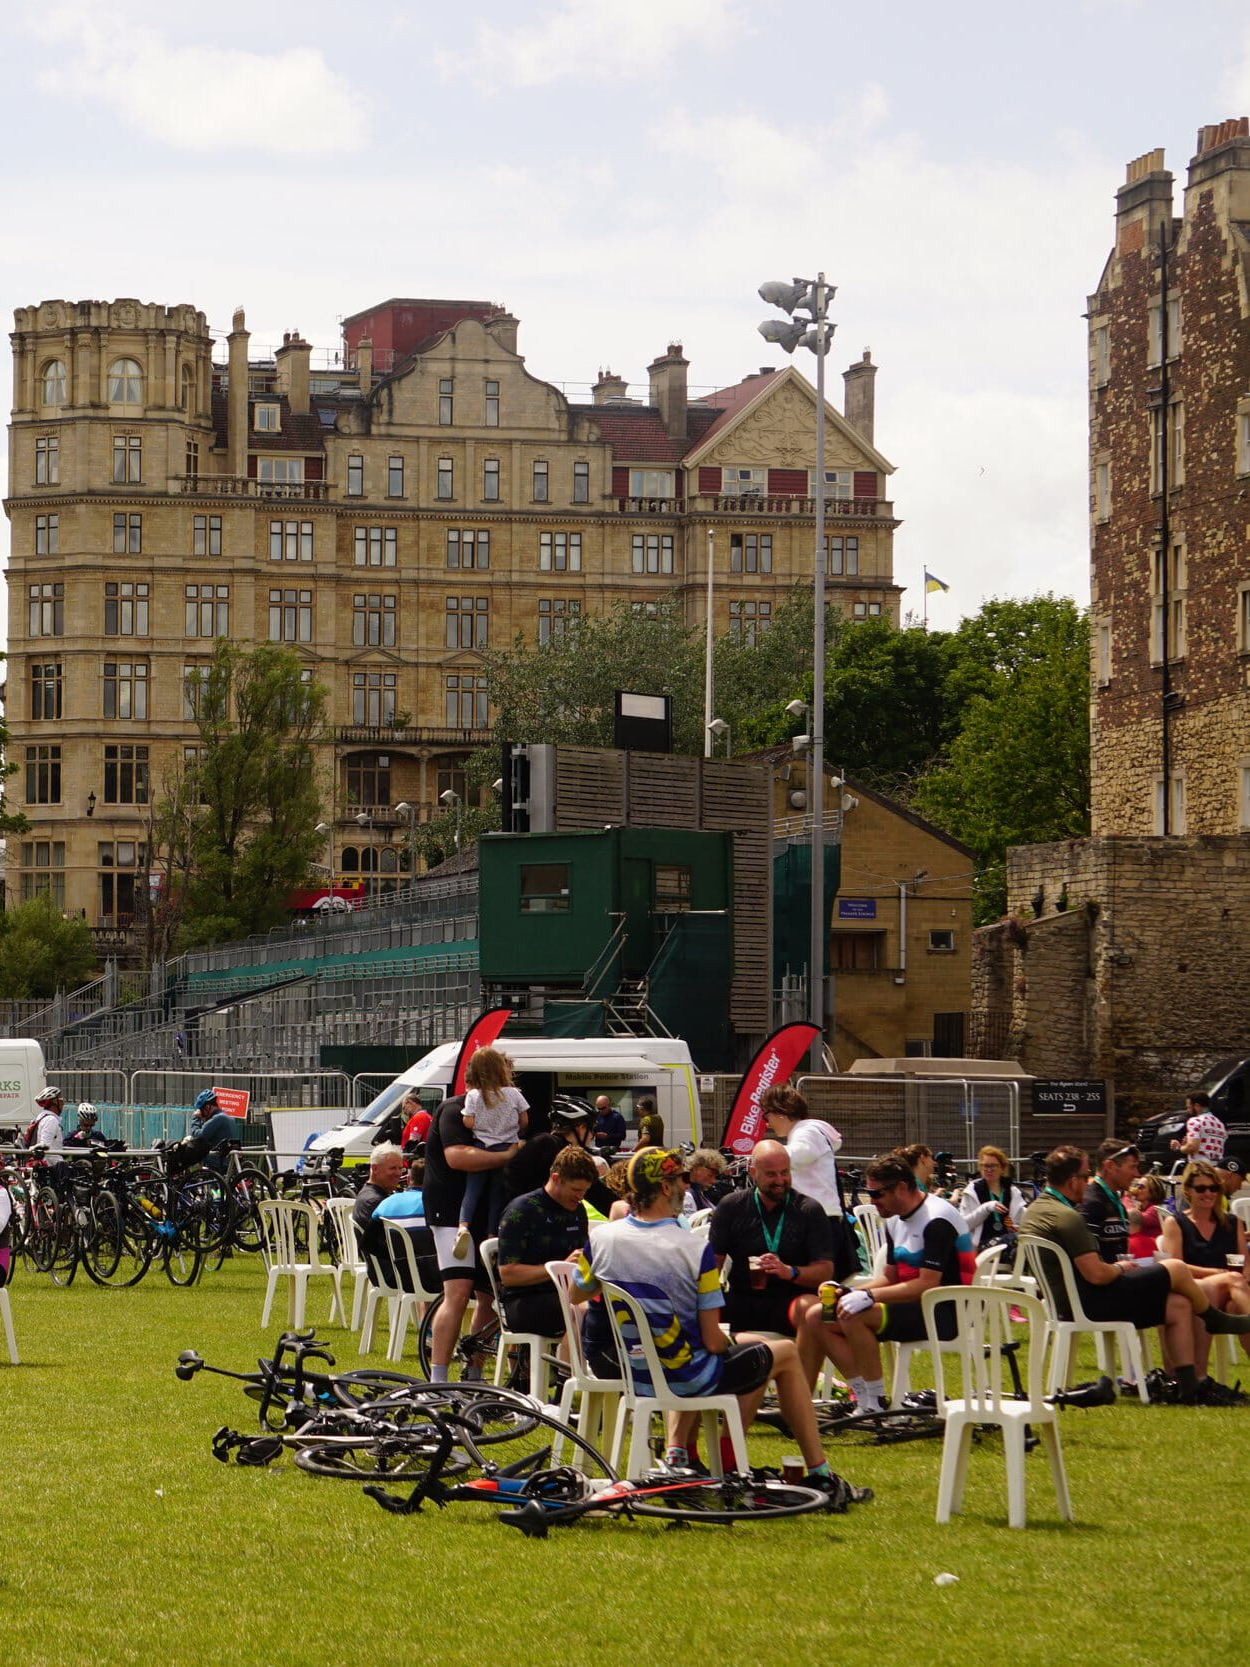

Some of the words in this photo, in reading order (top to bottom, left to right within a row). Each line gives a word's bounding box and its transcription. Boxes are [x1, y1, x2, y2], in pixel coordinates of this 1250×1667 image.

[565, 1072, 593, 1081] Mobile
[594, 1072, 619, 1081] Police
[621, 1072, 649, 1081] Station
[215, 1091, 245, 1100] EMERGENCY
[1038, 1092, 1064, 1101] SEATS
[1065, 1092, 1080, 1101] 238
[1086, 1092, 1101, 1101] 255
[219, 1099, 240, 1107] MEETING
